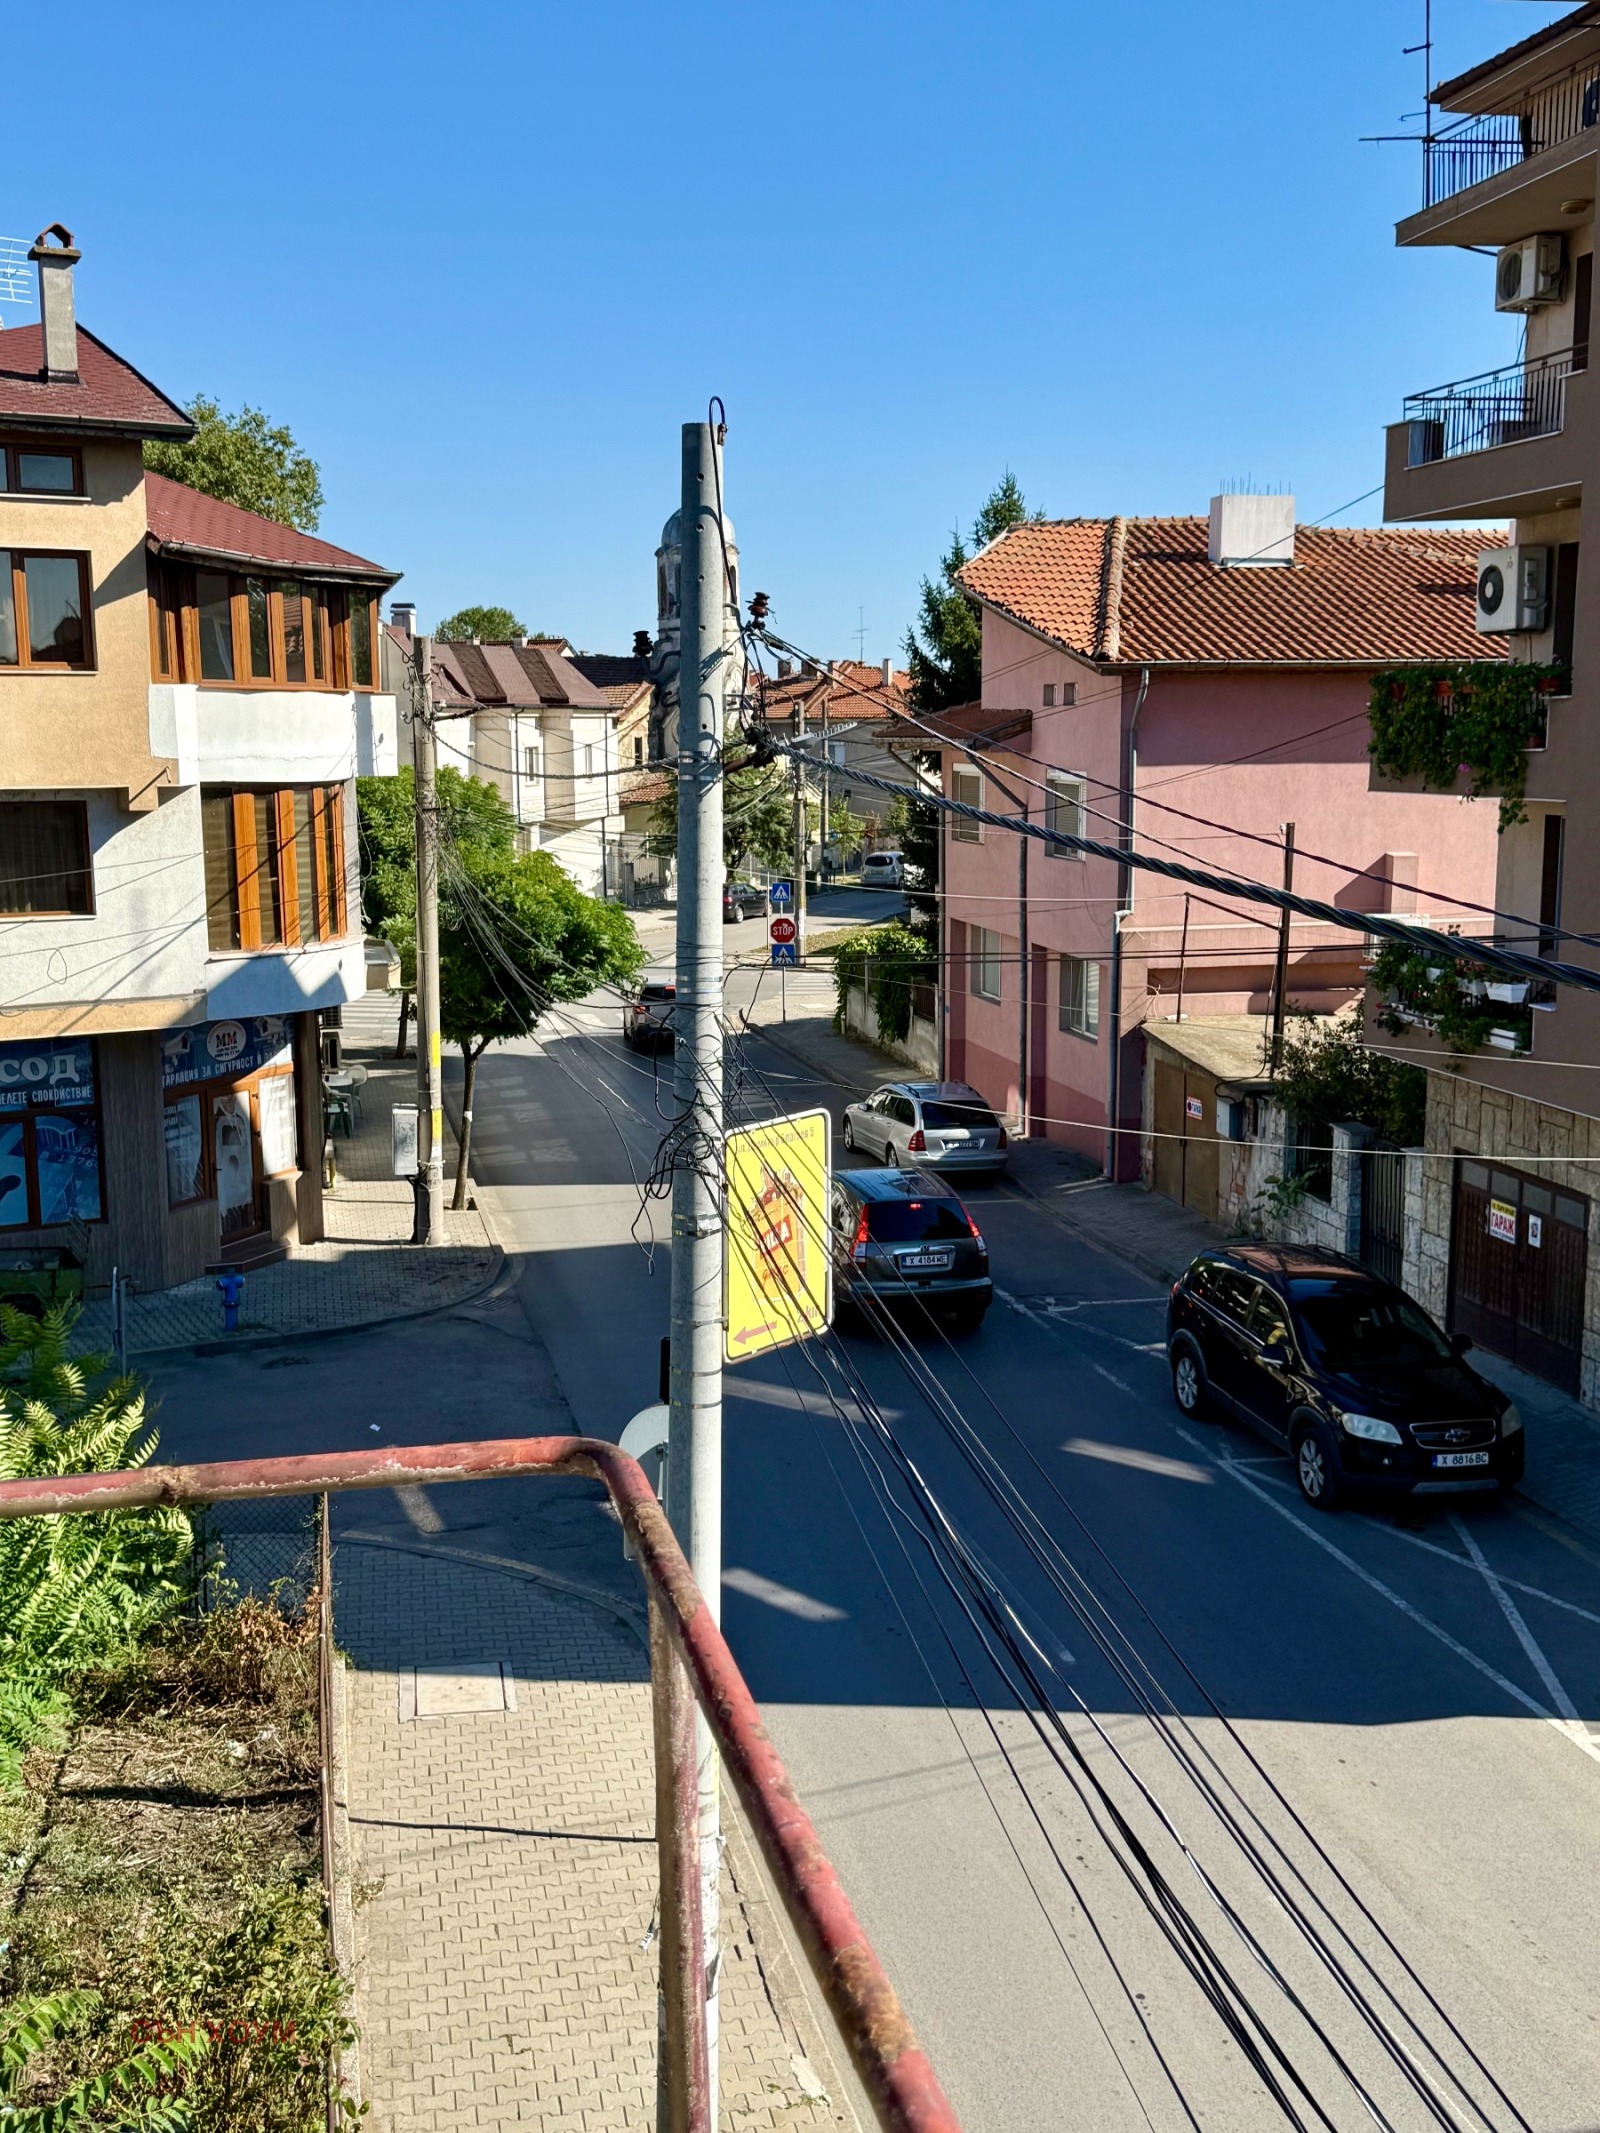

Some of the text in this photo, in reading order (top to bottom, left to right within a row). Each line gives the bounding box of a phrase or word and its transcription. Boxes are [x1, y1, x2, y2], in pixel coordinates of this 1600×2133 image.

[773, 926, 793, 936] STOP
[0, 1054, 80, 1085] СОД
[162, 1068, 199, 1087] ГАРАНЦИЯ
[202, 1065, 212, 1077] ЗА
[215, 1056, 254, 1074] СИГУРНОСТ
[32, 1085, 92, 1103] СПОКОЙСТВИЕ
[809, 1126, 814, 1137] 5
[1491, 1212, 1514, 1236] ГАРАЖ
